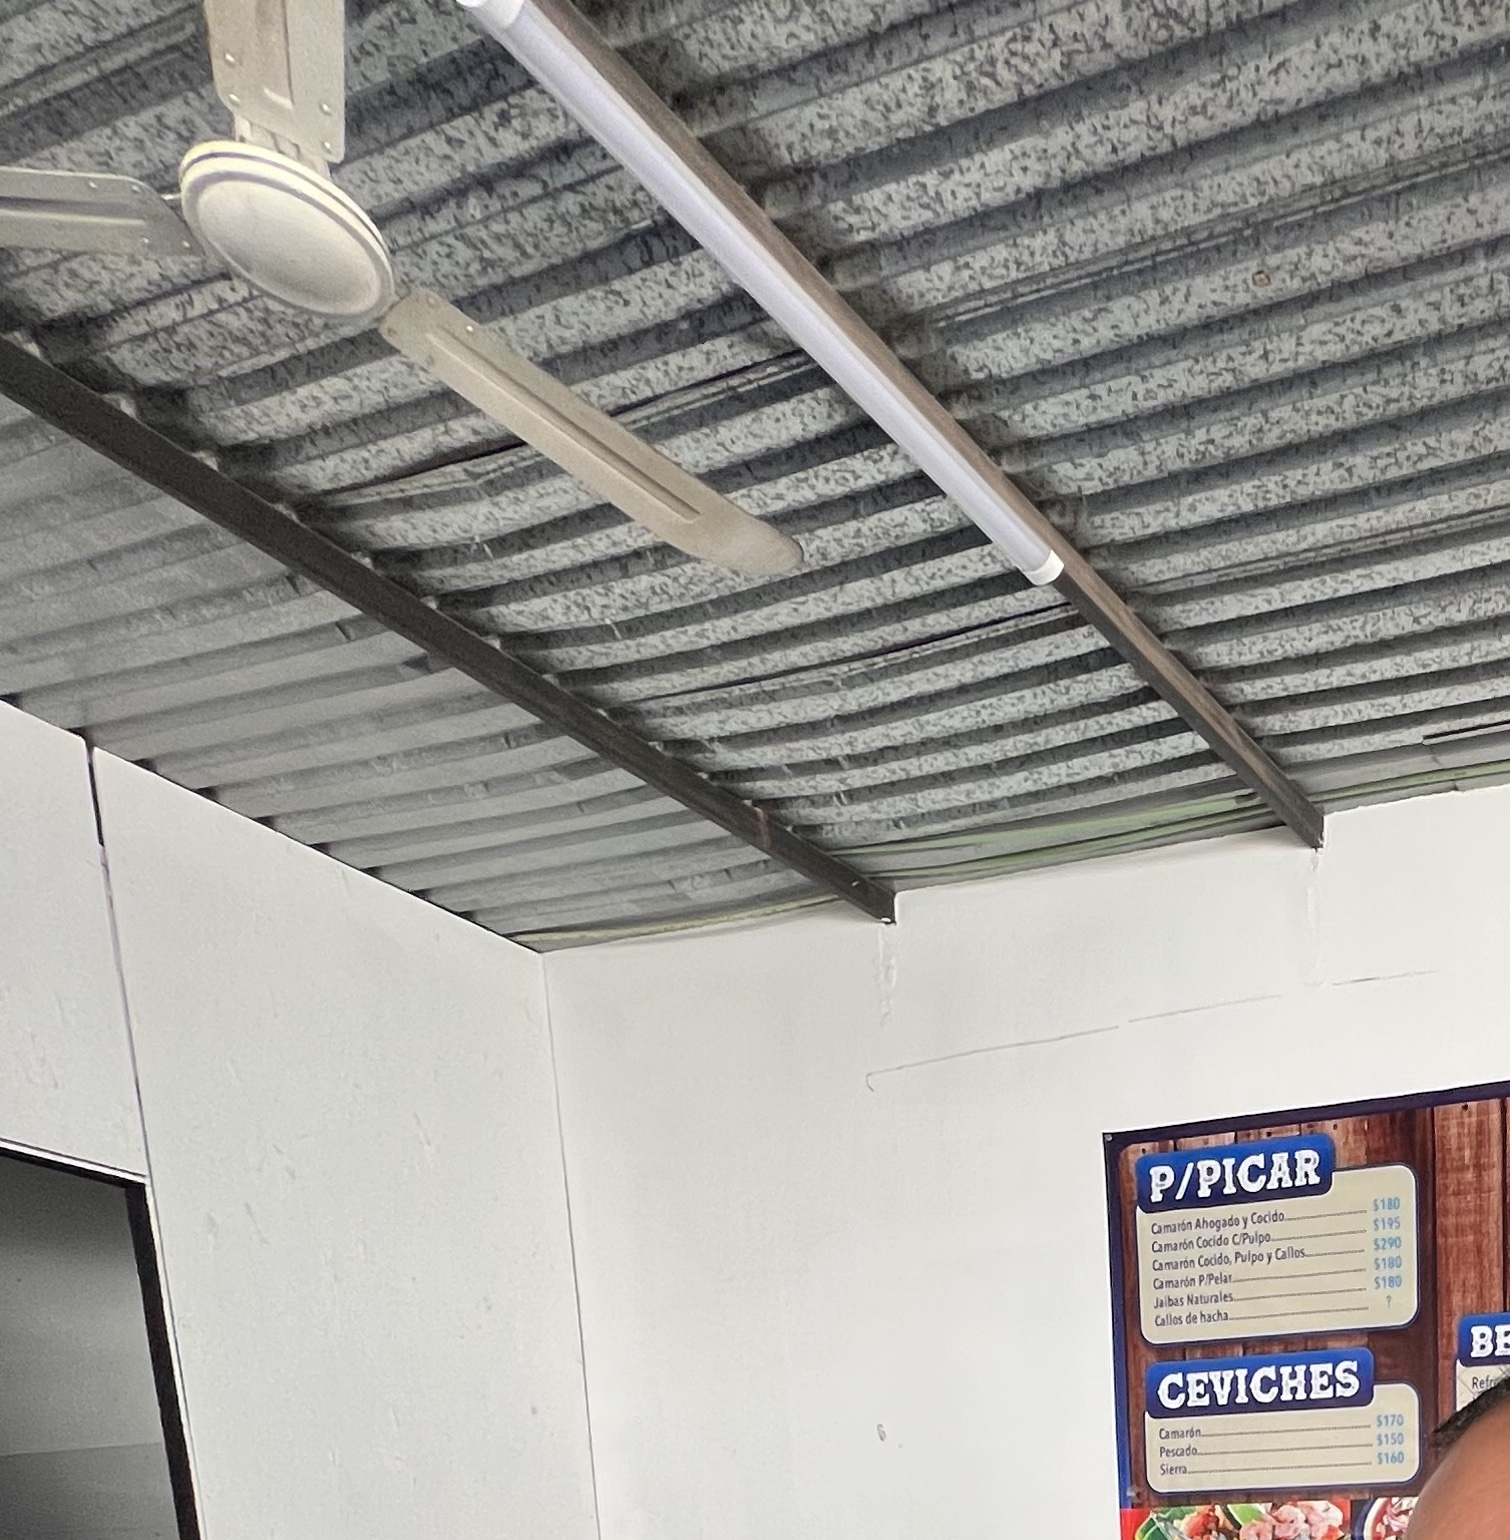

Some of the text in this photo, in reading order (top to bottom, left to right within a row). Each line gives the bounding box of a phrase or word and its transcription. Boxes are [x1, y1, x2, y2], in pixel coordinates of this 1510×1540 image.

[1149, 1149, 1321, 1202] P/PICAR
[1151, 1196, 1400, 1235] Camarón Ahogado y Cocido $180
[1152, 1217, 1400, 1253] Camarón Cocido C/Pulpo $195
[1152, 1258, 1195, 1272] Camarón
[1234, 1250, 1265, 1266] Pulpo
[1266, 1254, 1273, 1266] y
[1275, 1246, 1305, 1261] Callos
[1373, 1236, 1402, 1251] $290
[1153, 1255, 1402, 1290] Camarón P/Pelar $180
[1153, 1275, 1402, 1309] Jaibas Naturales $180
[1154, 1313, 1183, 1327] Callos
[1185, 1312, 1198, 1324] de
[1200, 1309, 1229, 1322] hacha
[1157, 1360, 1360, 1409] CEVICHES
[1159, 1414, 1404, 1440] Camarón $170
[1160, 1433, 1404, 1458] Pescado $150
[1160, 1451, 1405, 1476] Sierra $160
